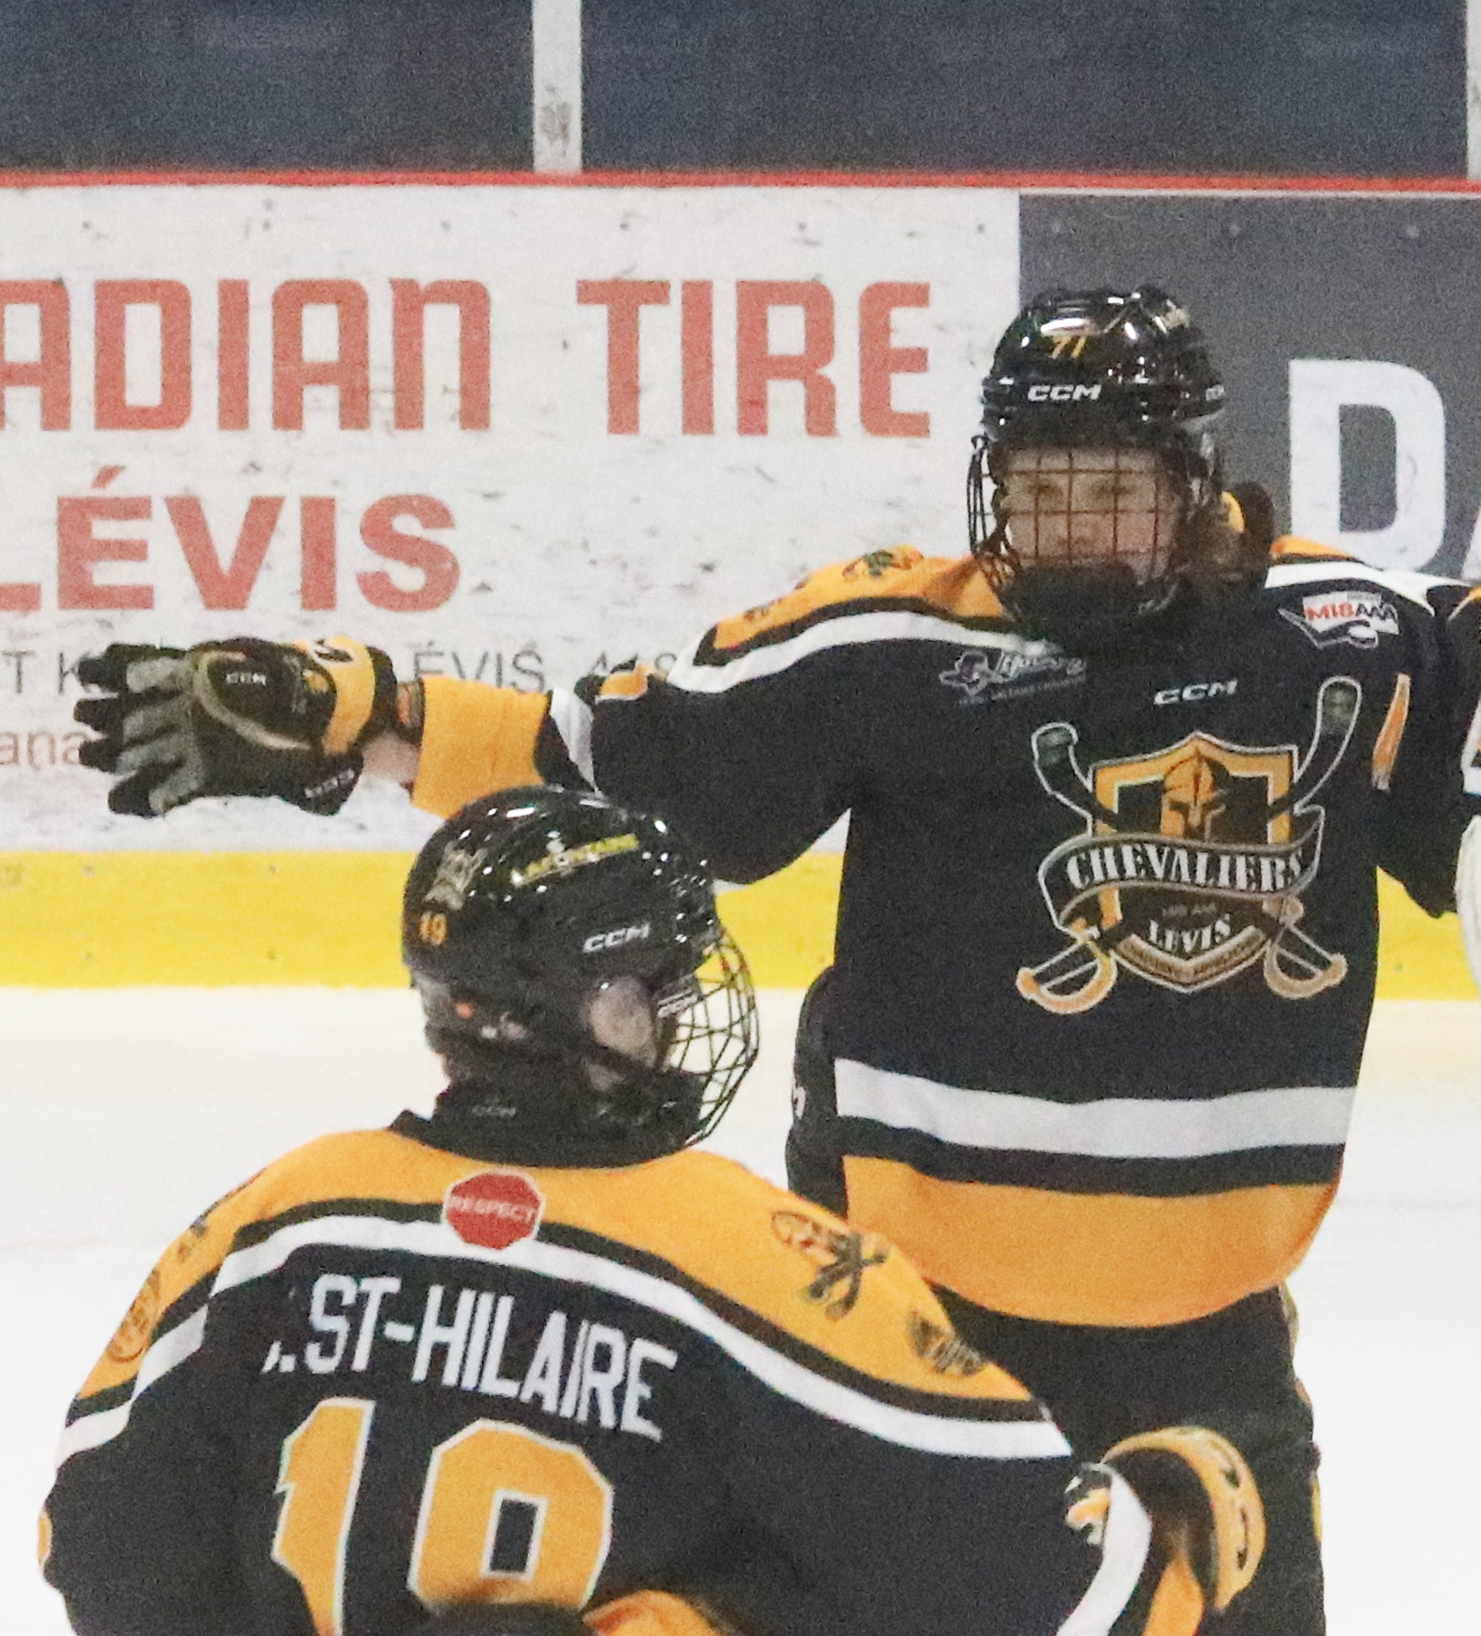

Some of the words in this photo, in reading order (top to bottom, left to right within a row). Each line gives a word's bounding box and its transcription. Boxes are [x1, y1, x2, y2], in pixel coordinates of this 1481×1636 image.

[575, 279, 932, 438] TIRE
[1027, 384, 1103, 401] CCM
[1154, 679, 1238, 705] CCM
[1067, 843, 1304, 893] CHEVALIERS
[583, 922, 651, 953] CCM
